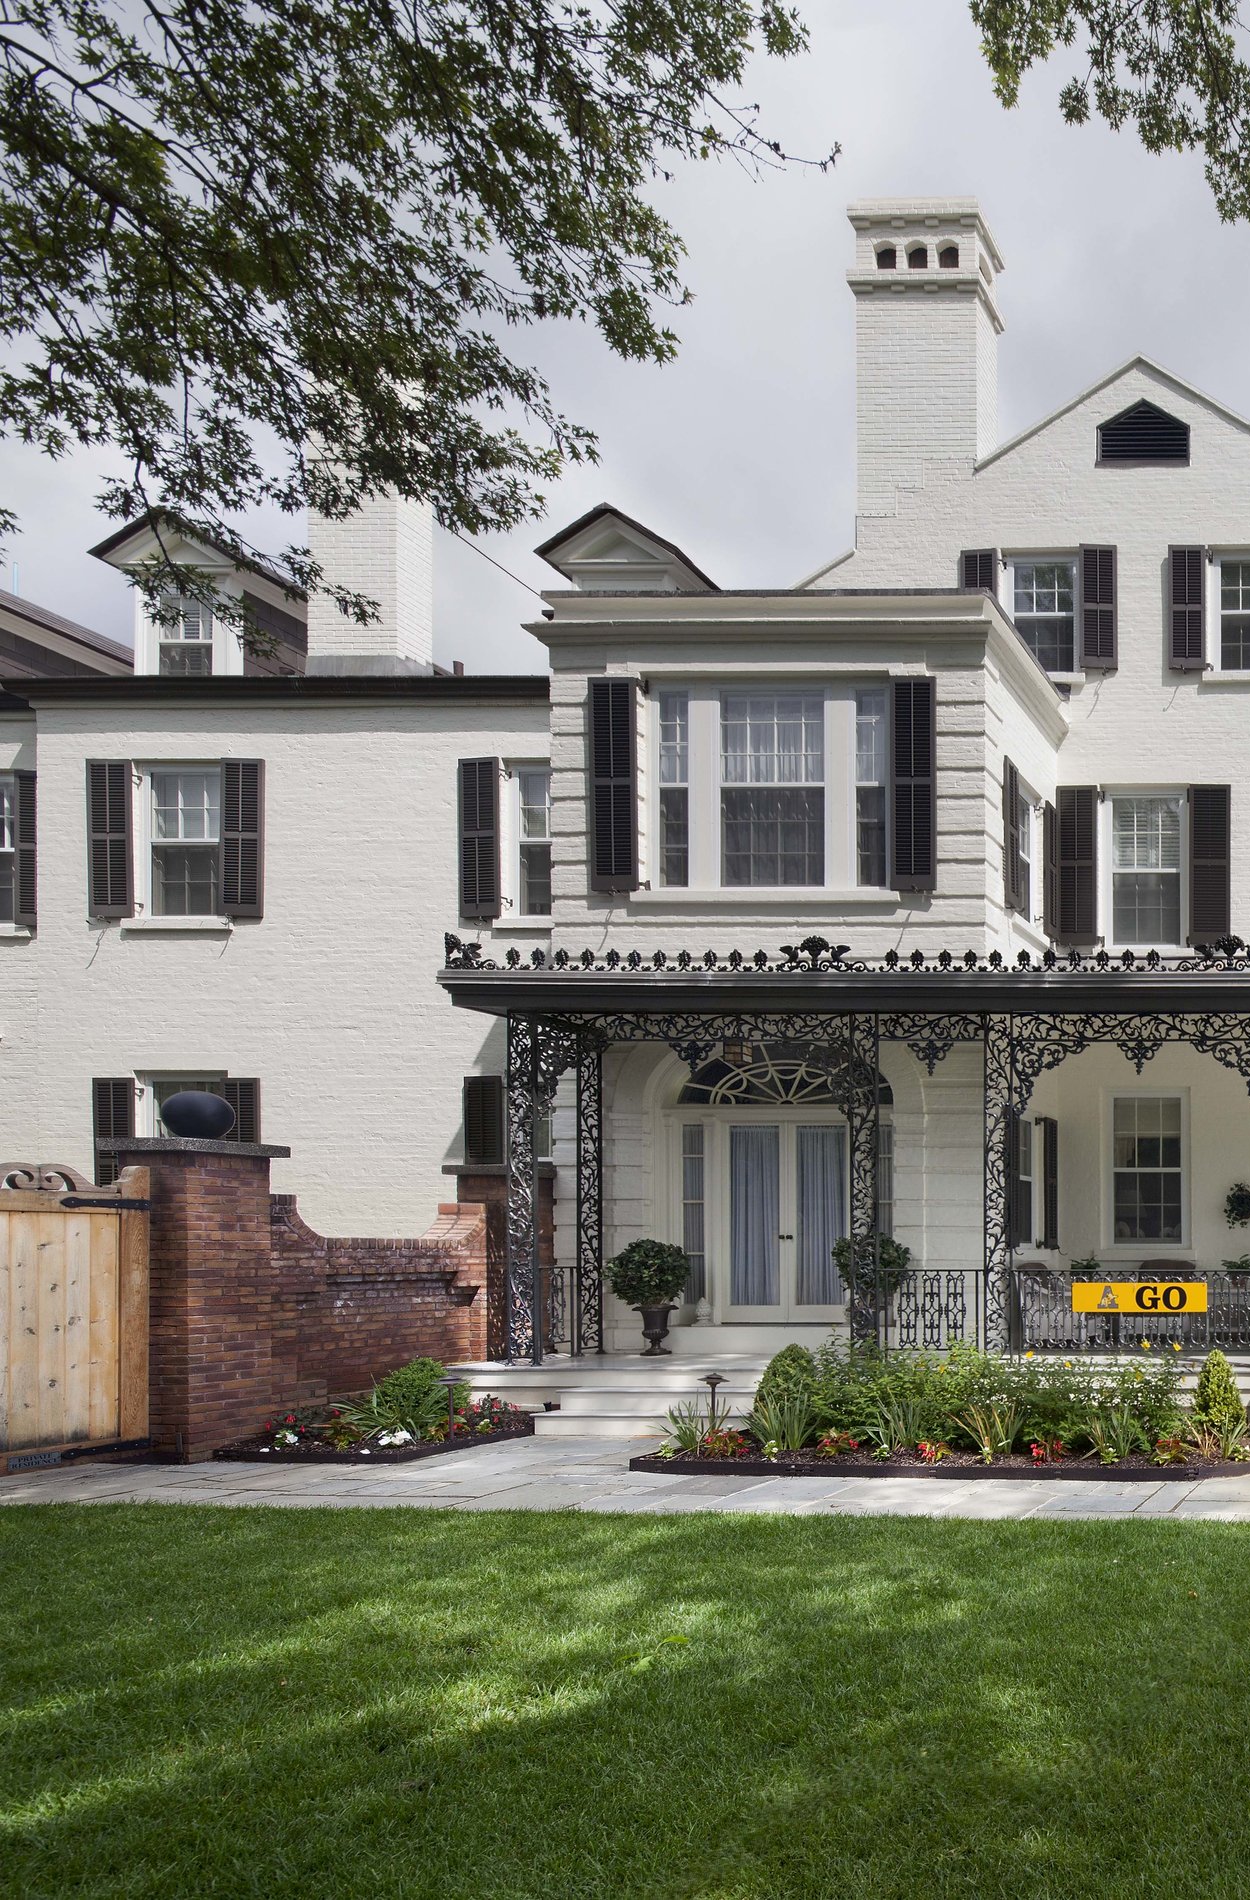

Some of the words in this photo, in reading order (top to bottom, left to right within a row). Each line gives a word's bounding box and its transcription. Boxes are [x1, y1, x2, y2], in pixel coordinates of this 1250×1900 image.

[1135, 1285, 1187, 1310] GO
[11, 1458, 57, 1469] RESIDENCE
[18, 1453, 51, 1463] PRIVATE
